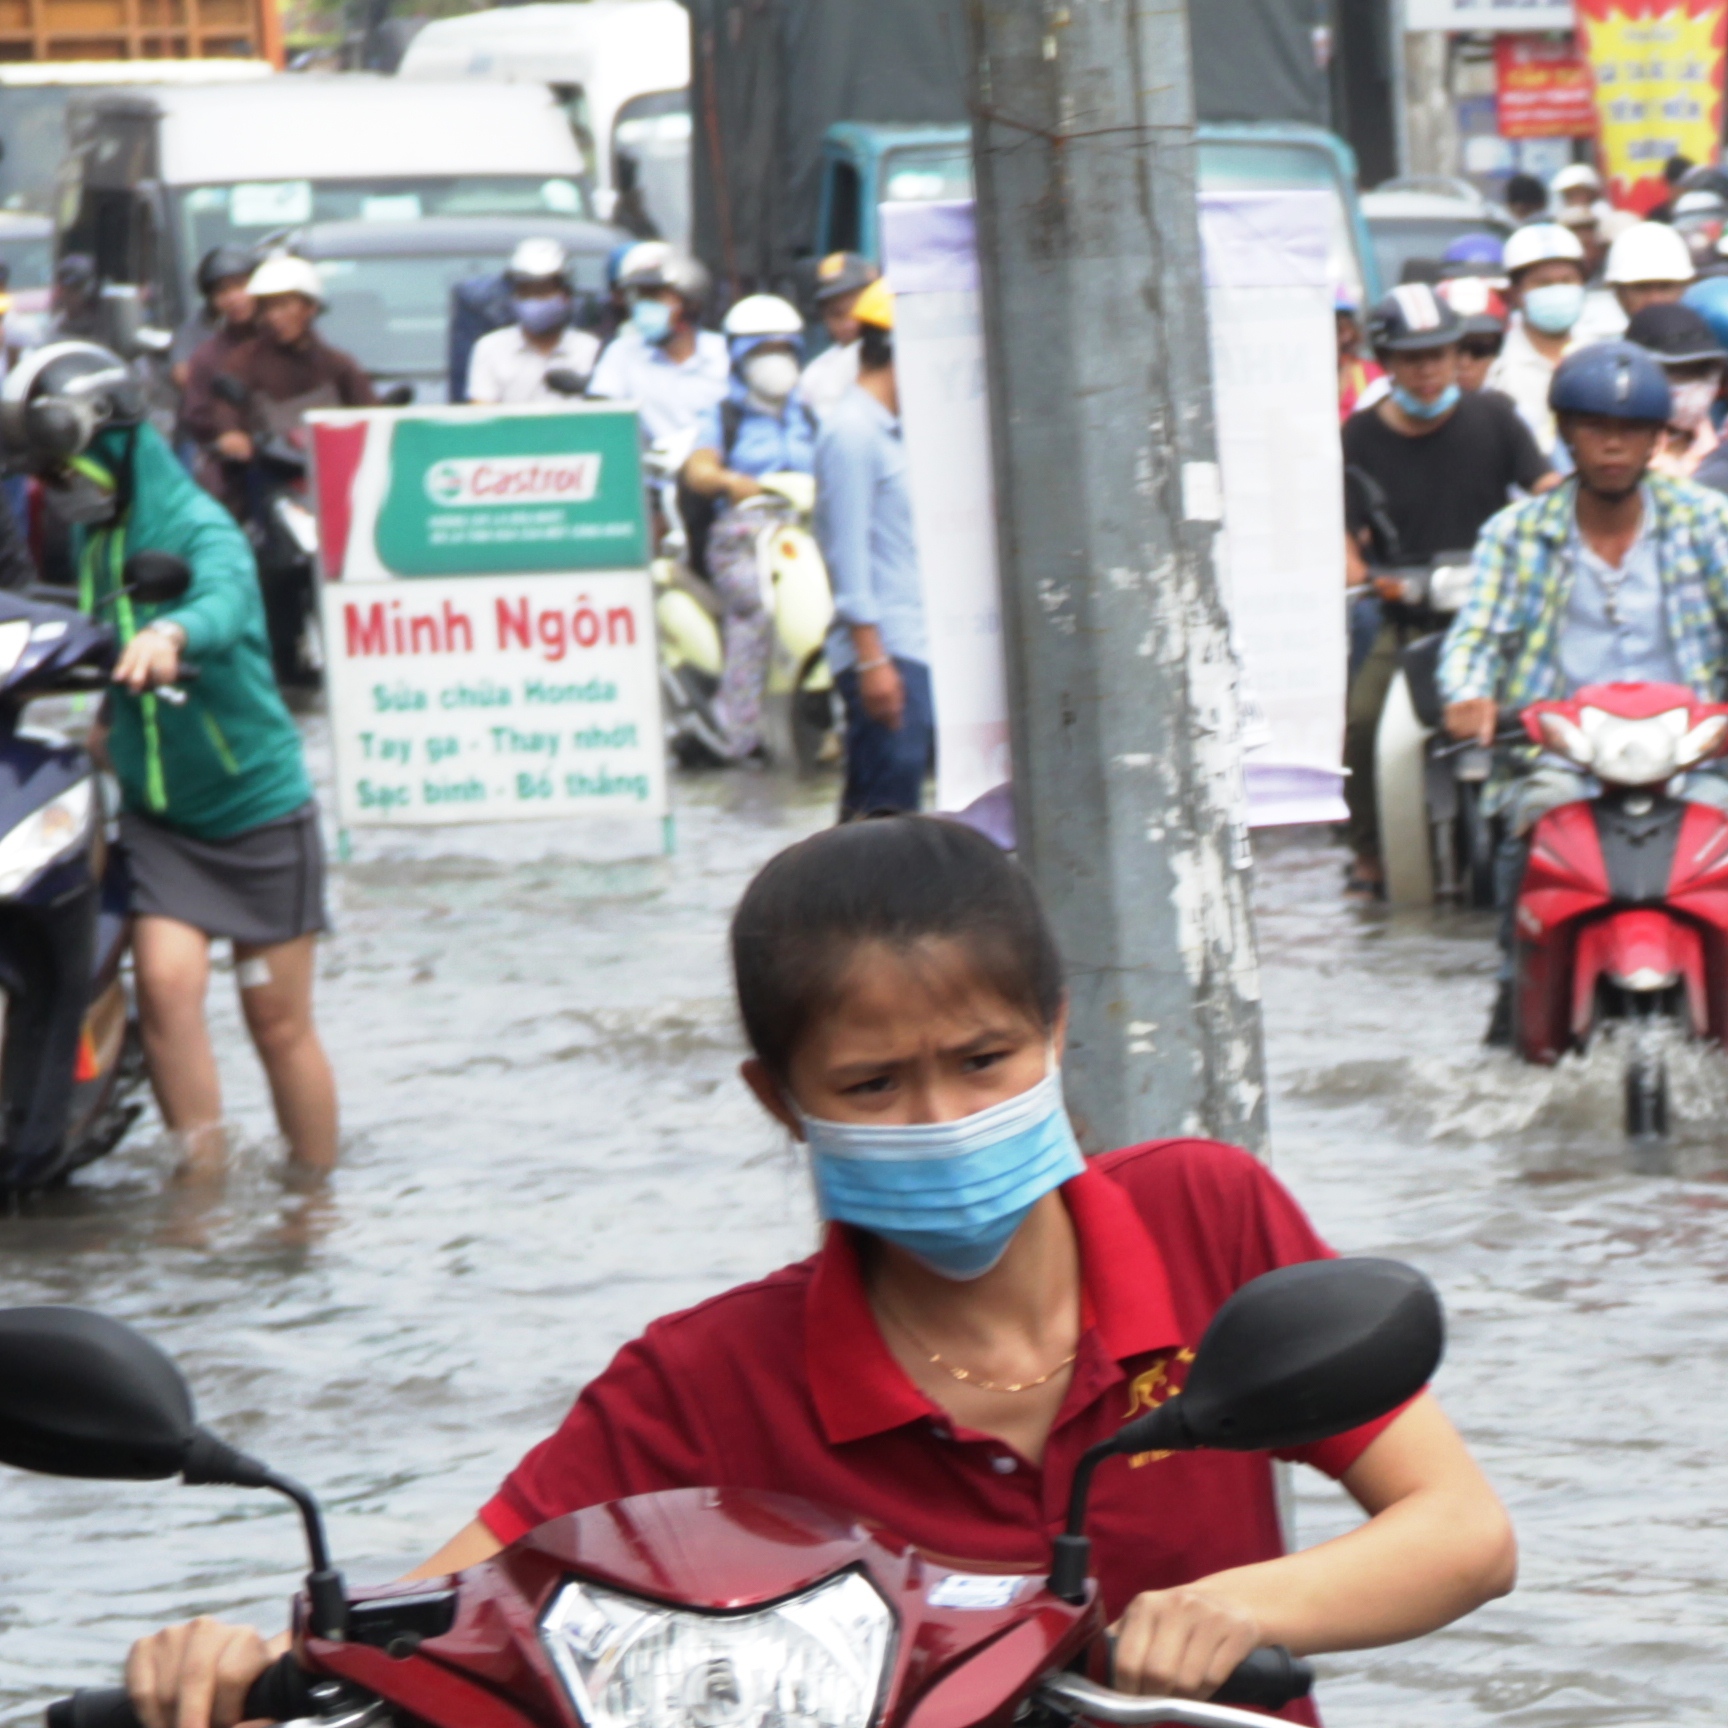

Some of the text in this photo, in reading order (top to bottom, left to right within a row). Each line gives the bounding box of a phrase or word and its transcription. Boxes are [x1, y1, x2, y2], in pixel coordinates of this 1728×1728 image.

[471, 462, 585, 496] Castrol
[344, 594, 637, 662] Minh Ngôn
[524, 674, 618, 704] Honda
[358, 731, 412, 765] Tay
[425, 736, 460, 764] ga
[490, 725, 560, 758] Thay
[356, 778, 410, 817] Sạc
